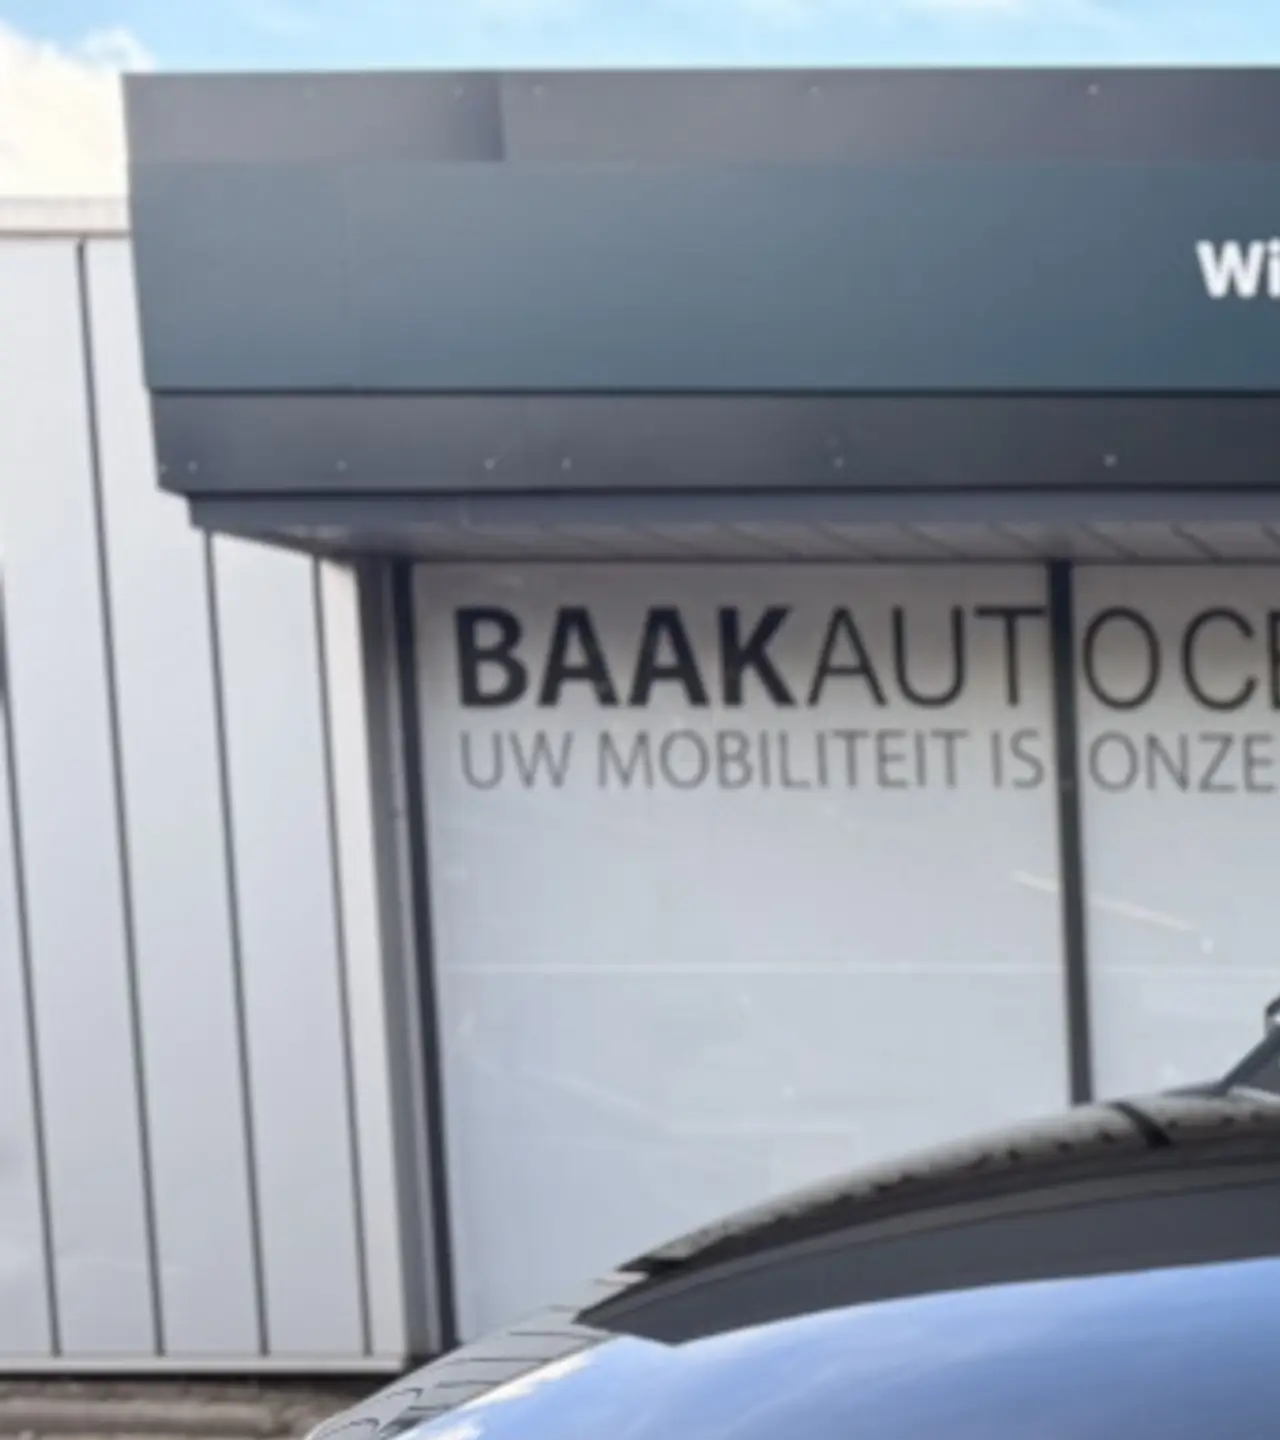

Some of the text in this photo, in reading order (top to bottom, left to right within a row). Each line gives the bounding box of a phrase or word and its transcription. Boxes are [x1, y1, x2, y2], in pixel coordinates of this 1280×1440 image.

[457, 728, 575, 791] UW
[597, 727, 971, 791] MOBILITEIT
[989, 728, 1048, 790] IS
[1088, 731, 1276, 794] ONZE
